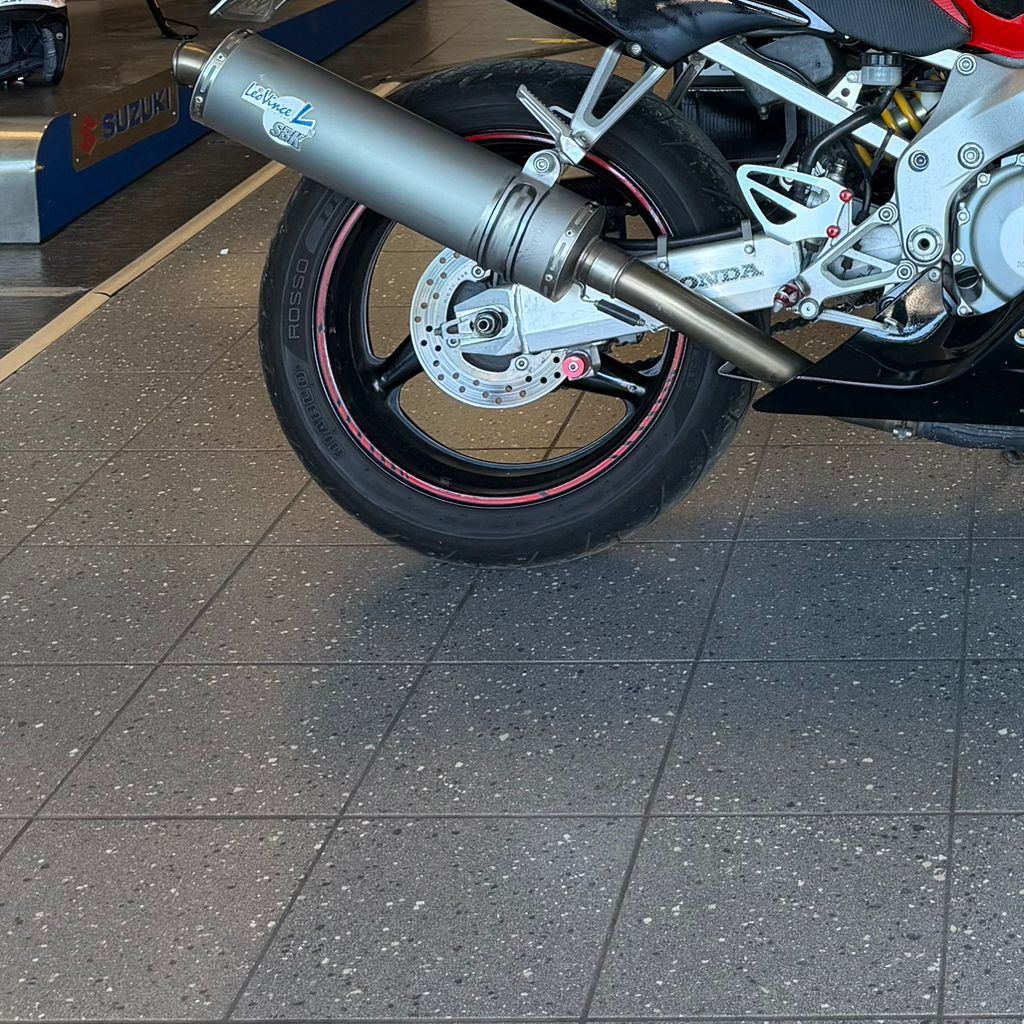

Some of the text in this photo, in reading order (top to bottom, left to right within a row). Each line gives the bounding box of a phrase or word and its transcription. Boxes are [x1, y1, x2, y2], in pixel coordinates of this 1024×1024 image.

[103, 86, 171, 141] SUZUKI
[245, 81, 292, 117] LeoVince
[269, 121, 307, 151] SBK
[288, 258, 309, 340] ROSSO
[681, 262, 766, 291] ONDA
[295, 370, 345, 458] DIABLO
